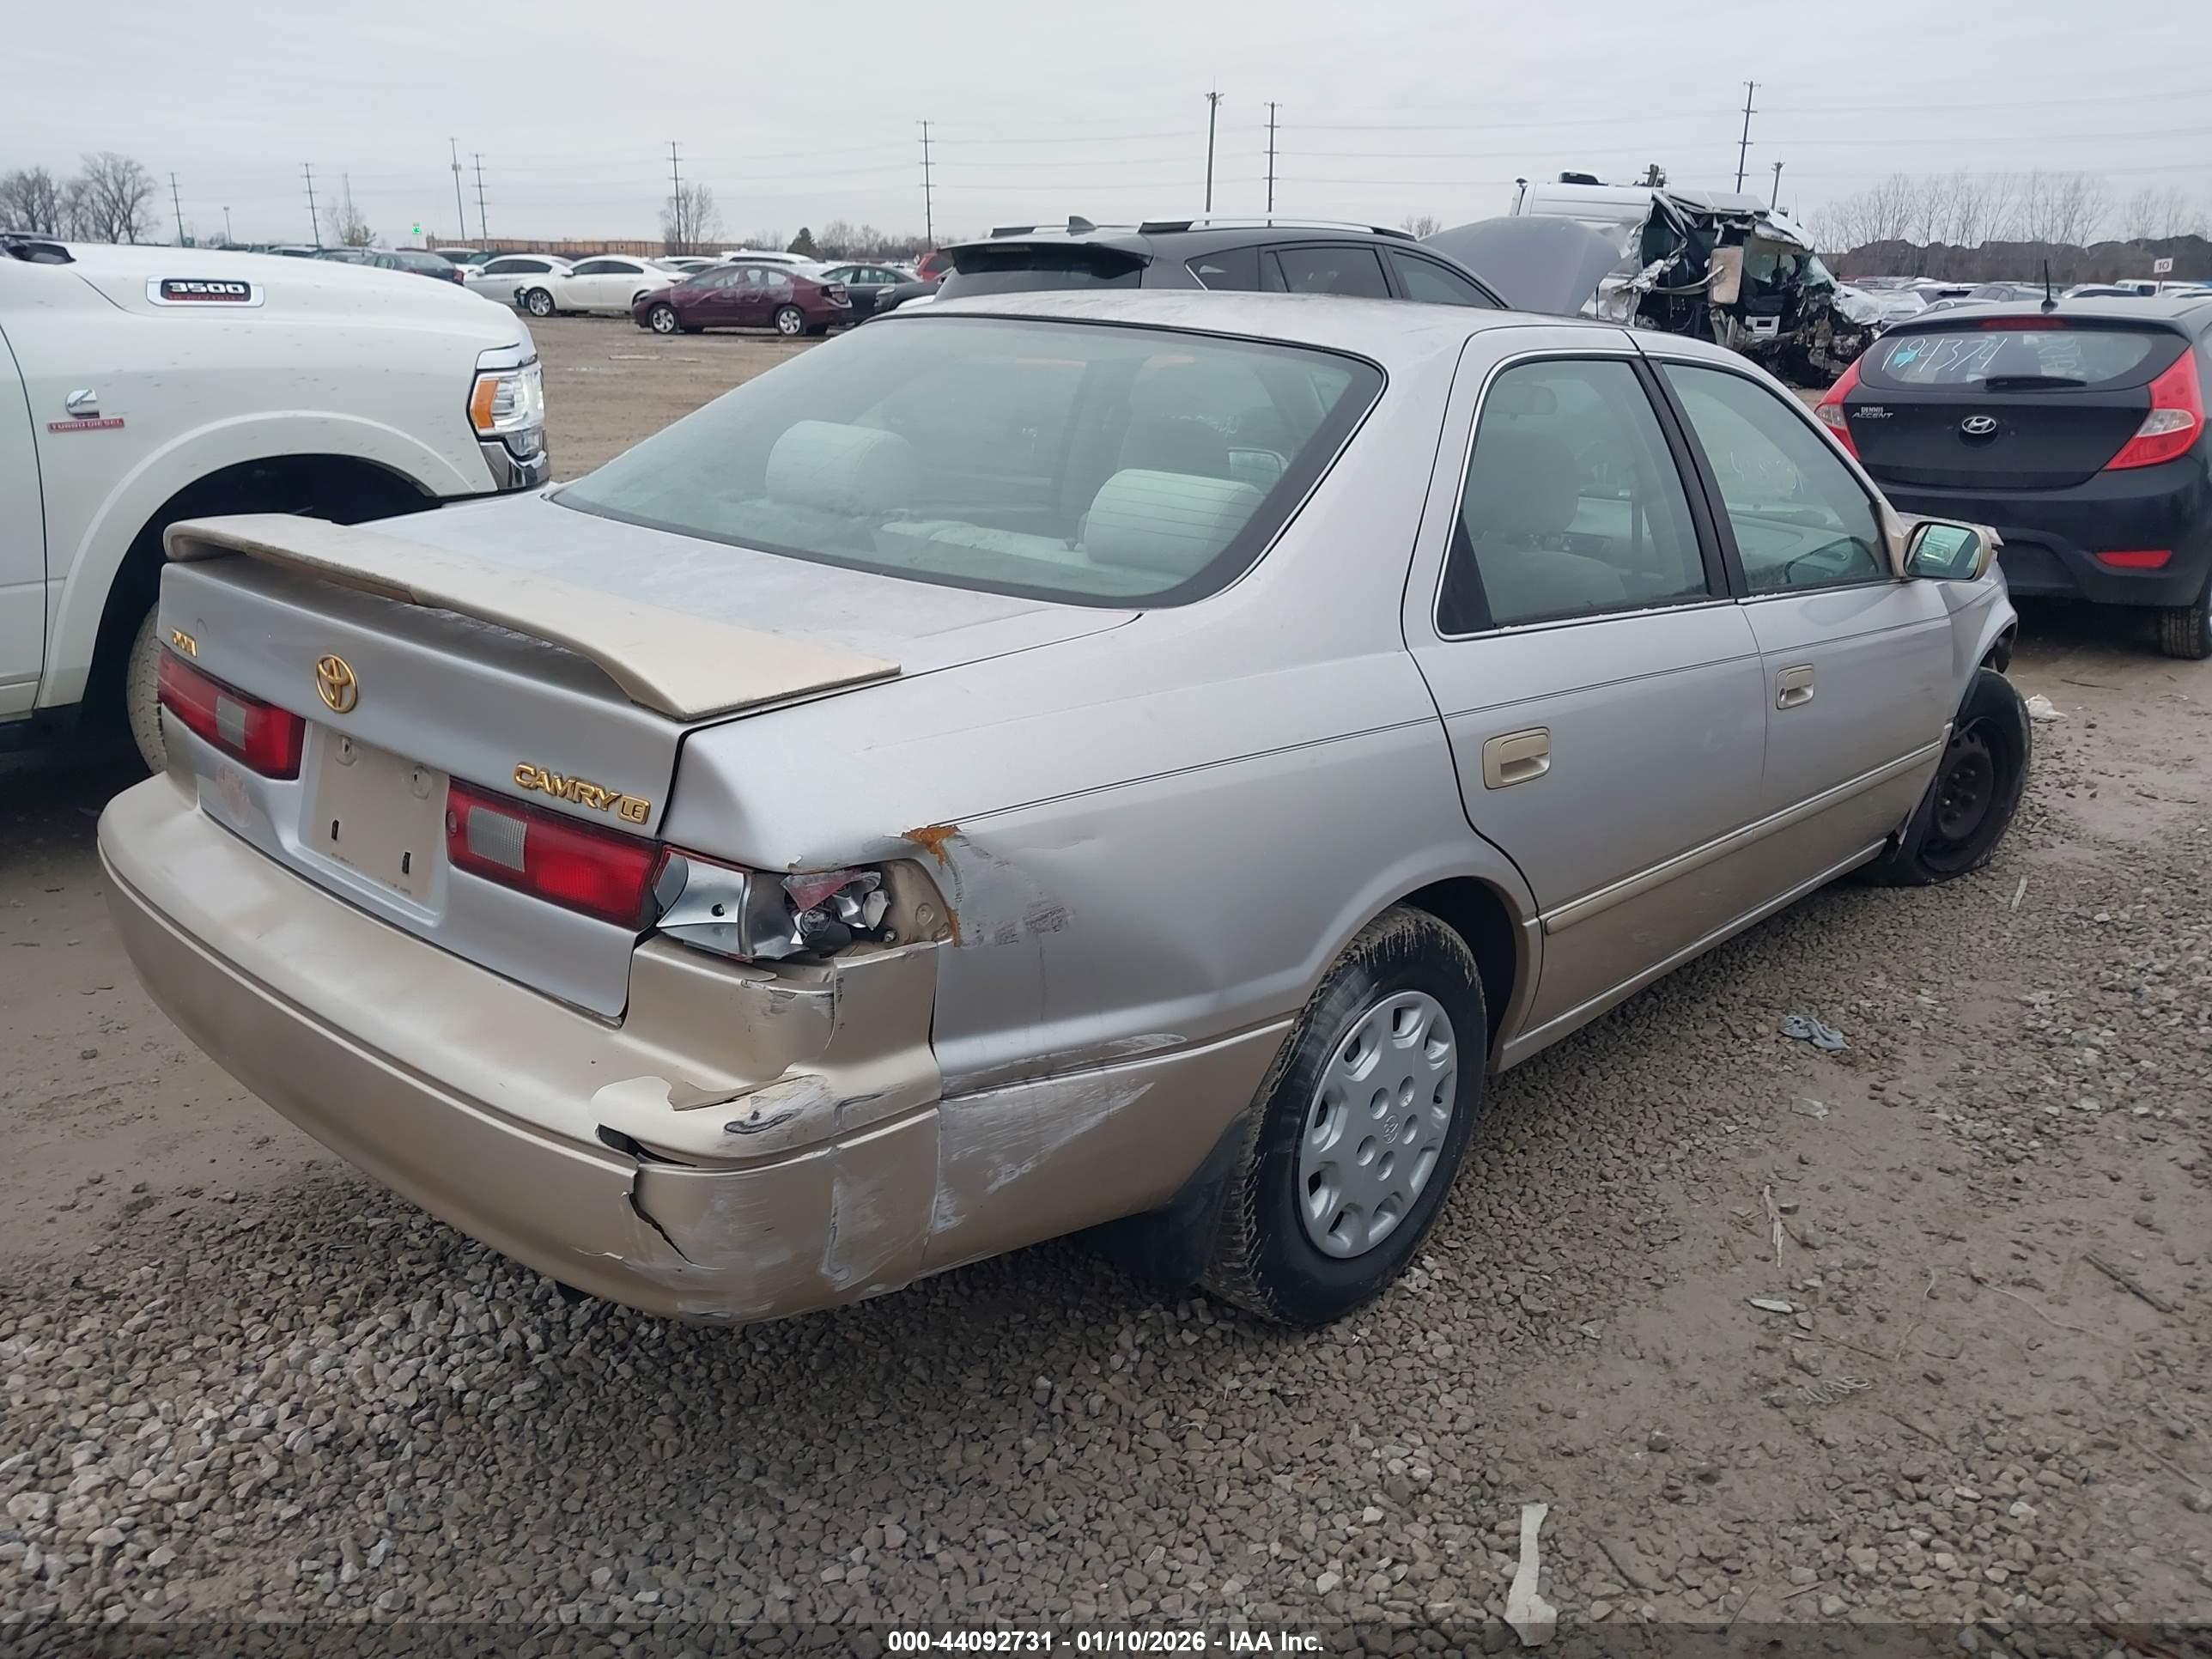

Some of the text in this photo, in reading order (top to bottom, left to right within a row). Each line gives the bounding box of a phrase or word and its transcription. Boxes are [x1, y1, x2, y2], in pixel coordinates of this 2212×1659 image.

[2158, 260, 2170, 270] 10
[168, 282, 246, 294] 3500
[514, 762, 647, 822] CAMRY LE
